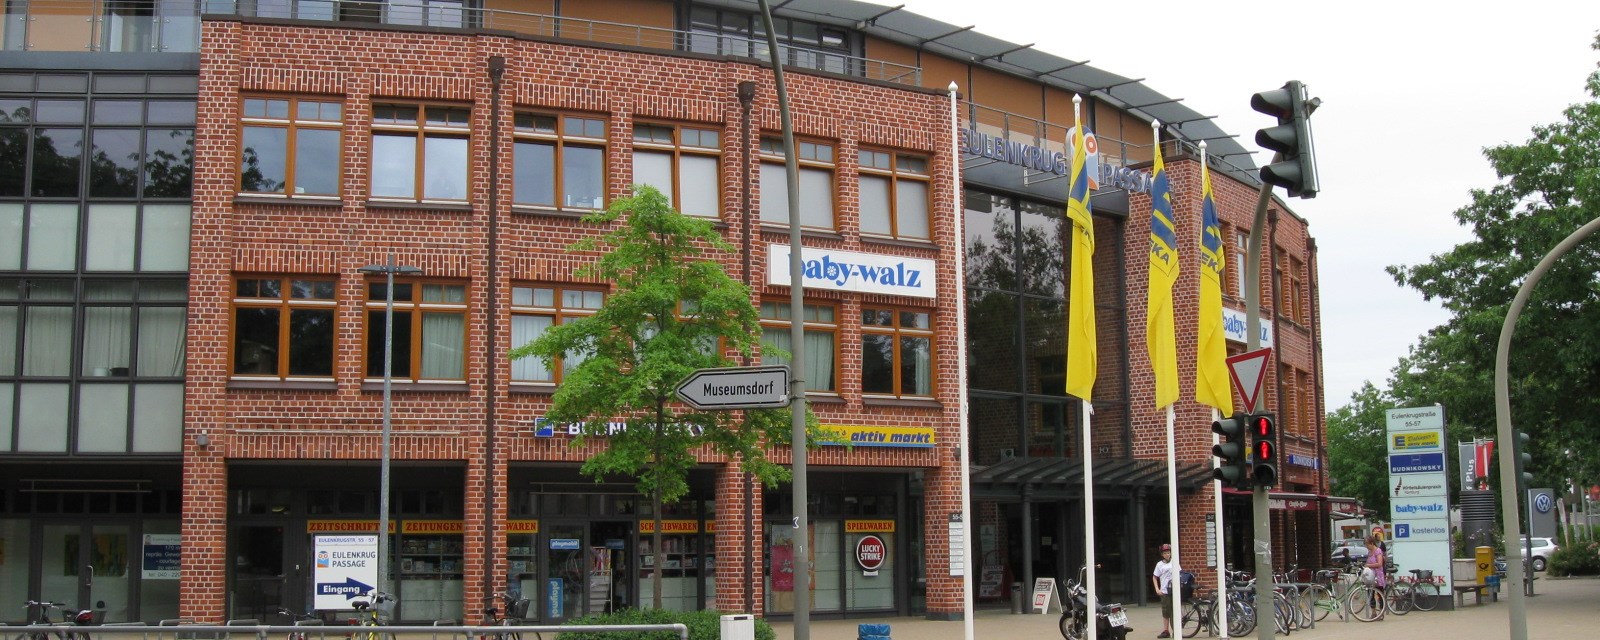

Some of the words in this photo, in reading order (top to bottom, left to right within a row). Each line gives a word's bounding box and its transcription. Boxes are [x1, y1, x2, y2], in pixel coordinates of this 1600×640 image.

[961, 128, 1065, 175] EULENKRUG
[1102, 163, 1173, 196] PASSA
[1222, 311, 1268, 341] baby-lz
[703, 381, 773, 396] Museumsdorf
[851, 431, 886, 441] aktiv
[890, 432, 930, 443] markt
[1466, 459, 1474, 483] Plus
[1395, 503, 1444, 513] baby-walz
[308, 522, 395, 531] ZEITSCHRIFTN
[405, 522, 463, 531] ZEITUNGEN
[640, 522, 697, 531] SCHEIBWAREN
[847, 522, 893, 531] SPIELWAREN
[861, 544, 880, 552] LUCKY
[332, 551, 376, 559] EULENKRUG
[860, 553, 881, 561] STRIKE
[332, 560, 366, 568] PASSAGE
[323, 585, 360, 594] Eingang
